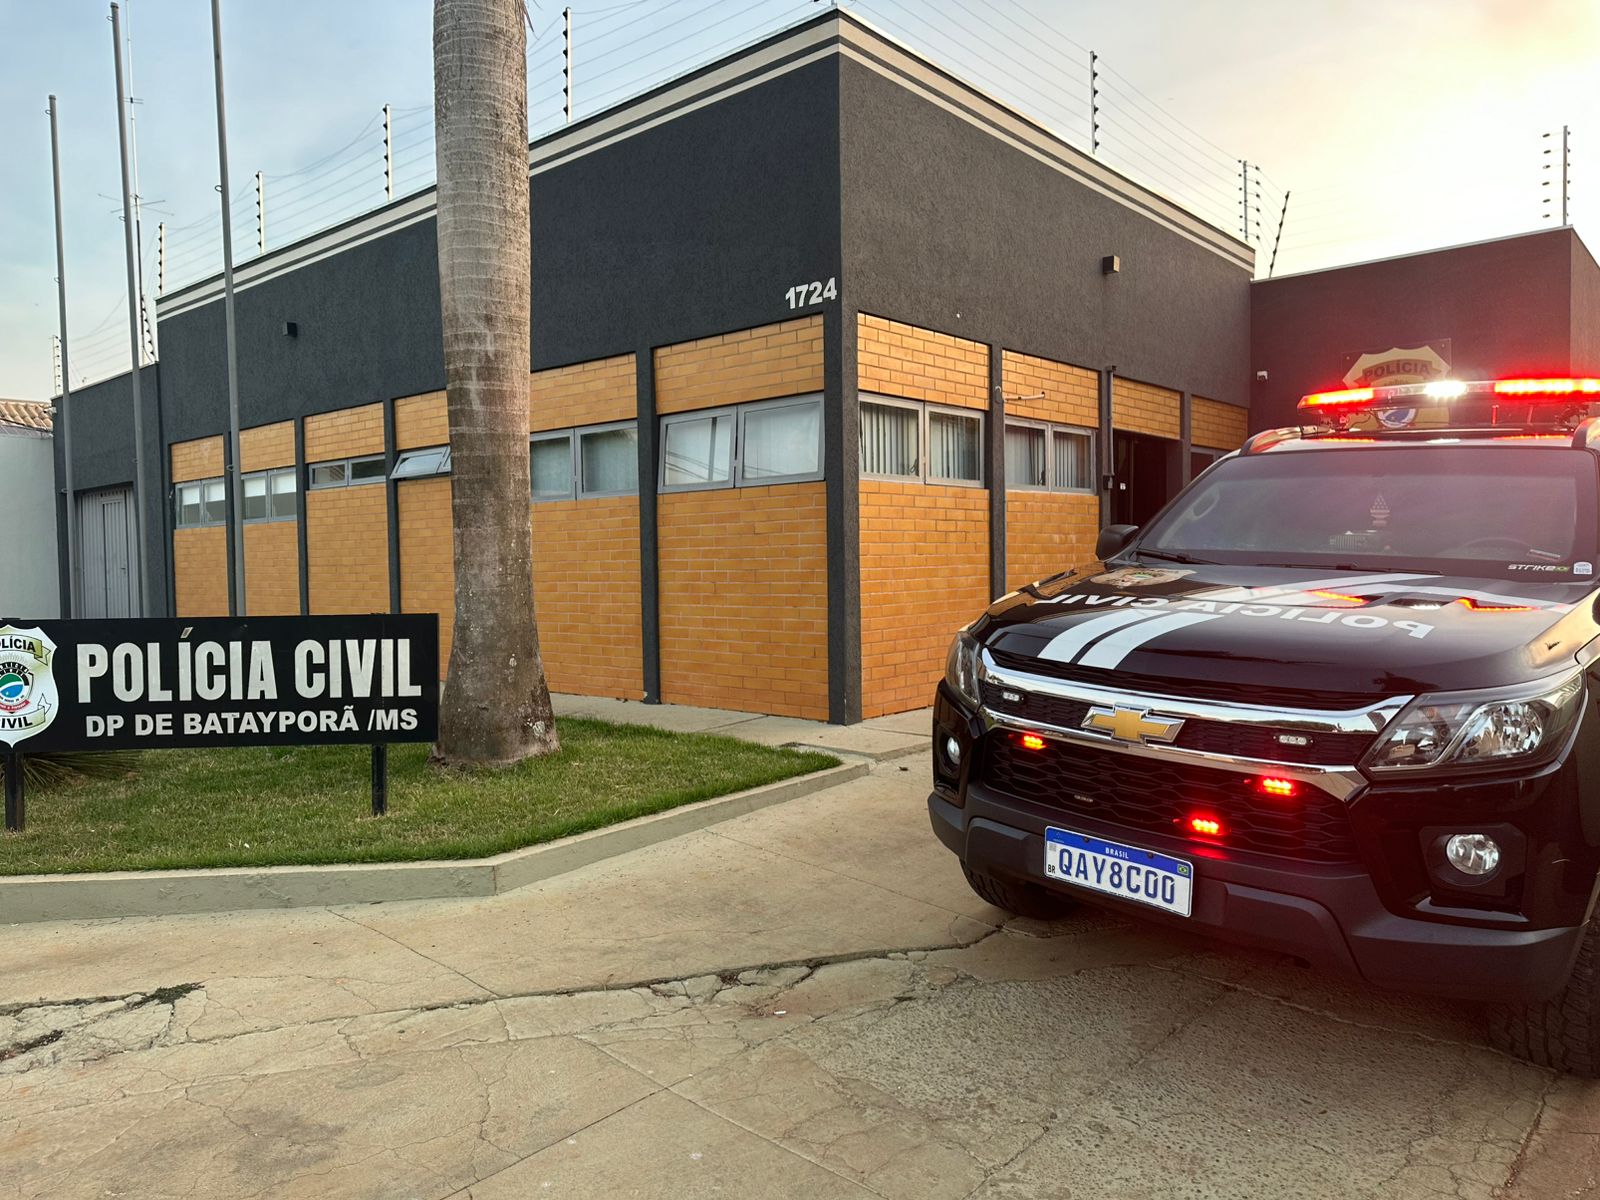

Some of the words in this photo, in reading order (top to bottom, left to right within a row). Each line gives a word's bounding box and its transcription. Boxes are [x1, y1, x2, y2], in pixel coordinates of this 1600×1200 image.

[785, 277, 838, 309] 1724
[0, 636, 36, 653] LÍCIA
[76, 627, 278, 703] POLÍCIA
[295, 638, 422, 698] CIVIL
[0, 716, 33, 729] IVIL
[86, 714, 124, 737] DP
[135, 713, 174, 736] DE
[184, 705, 359, 735] BATAYPORÃ
[367, 708, 419, 731] /MS
[1105, 847, 1129, 859] BRASIL
[1047, 864, 1056, 874] BR
[1059, 848, 1175, 904] QAY8C00
